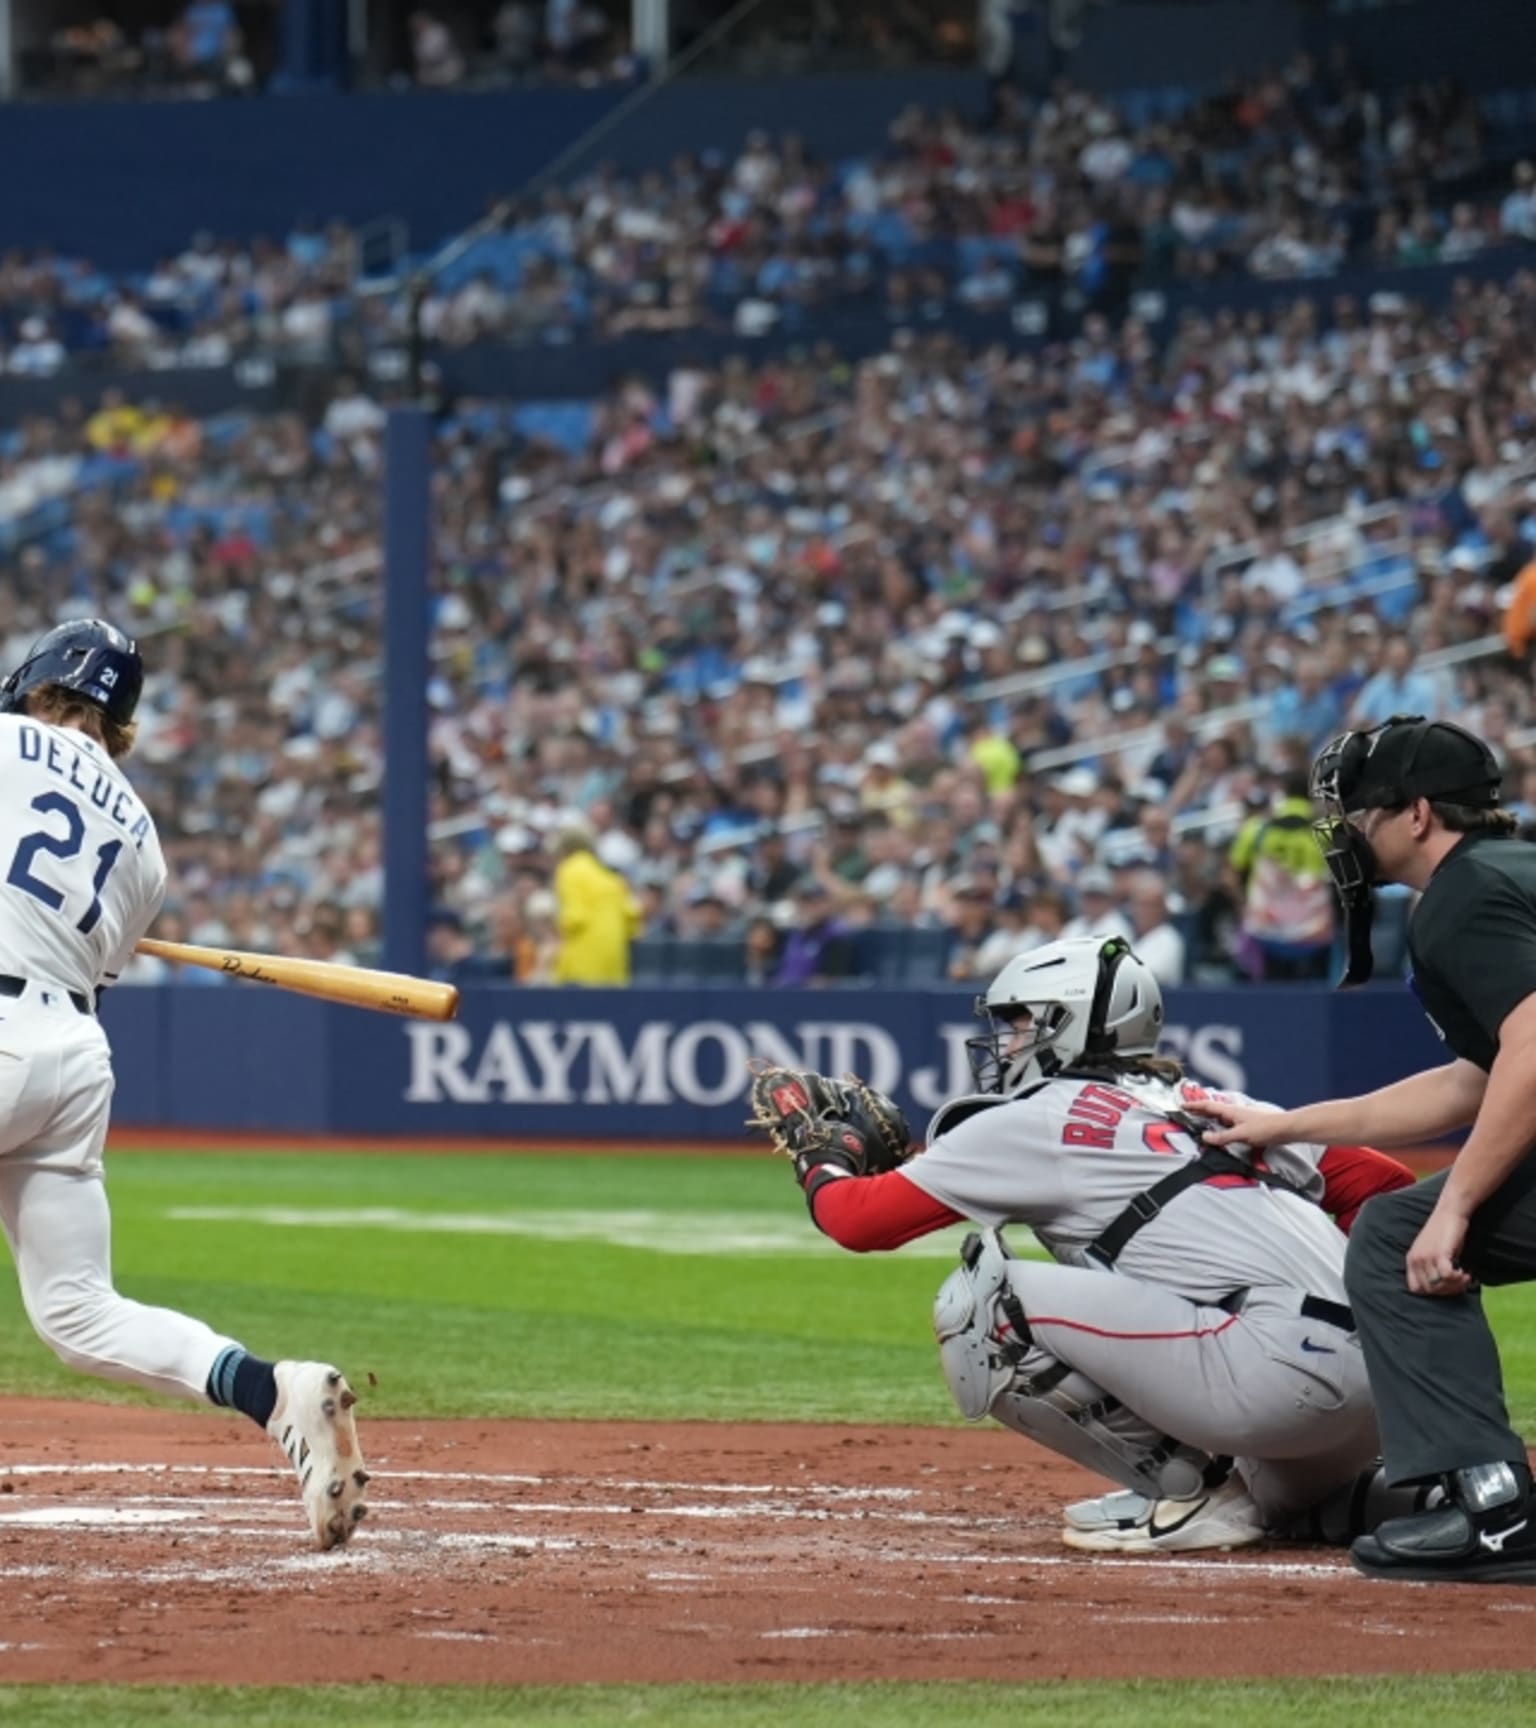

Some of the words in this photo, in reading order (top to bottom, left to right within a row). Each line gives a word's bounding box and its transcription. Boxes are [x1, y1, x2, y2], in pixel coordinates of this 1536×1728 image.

[100, 667, 119, 688] 21
[6, 791, 124, 935] 21
[406, 1022, 900, 1105] RAYMOND
